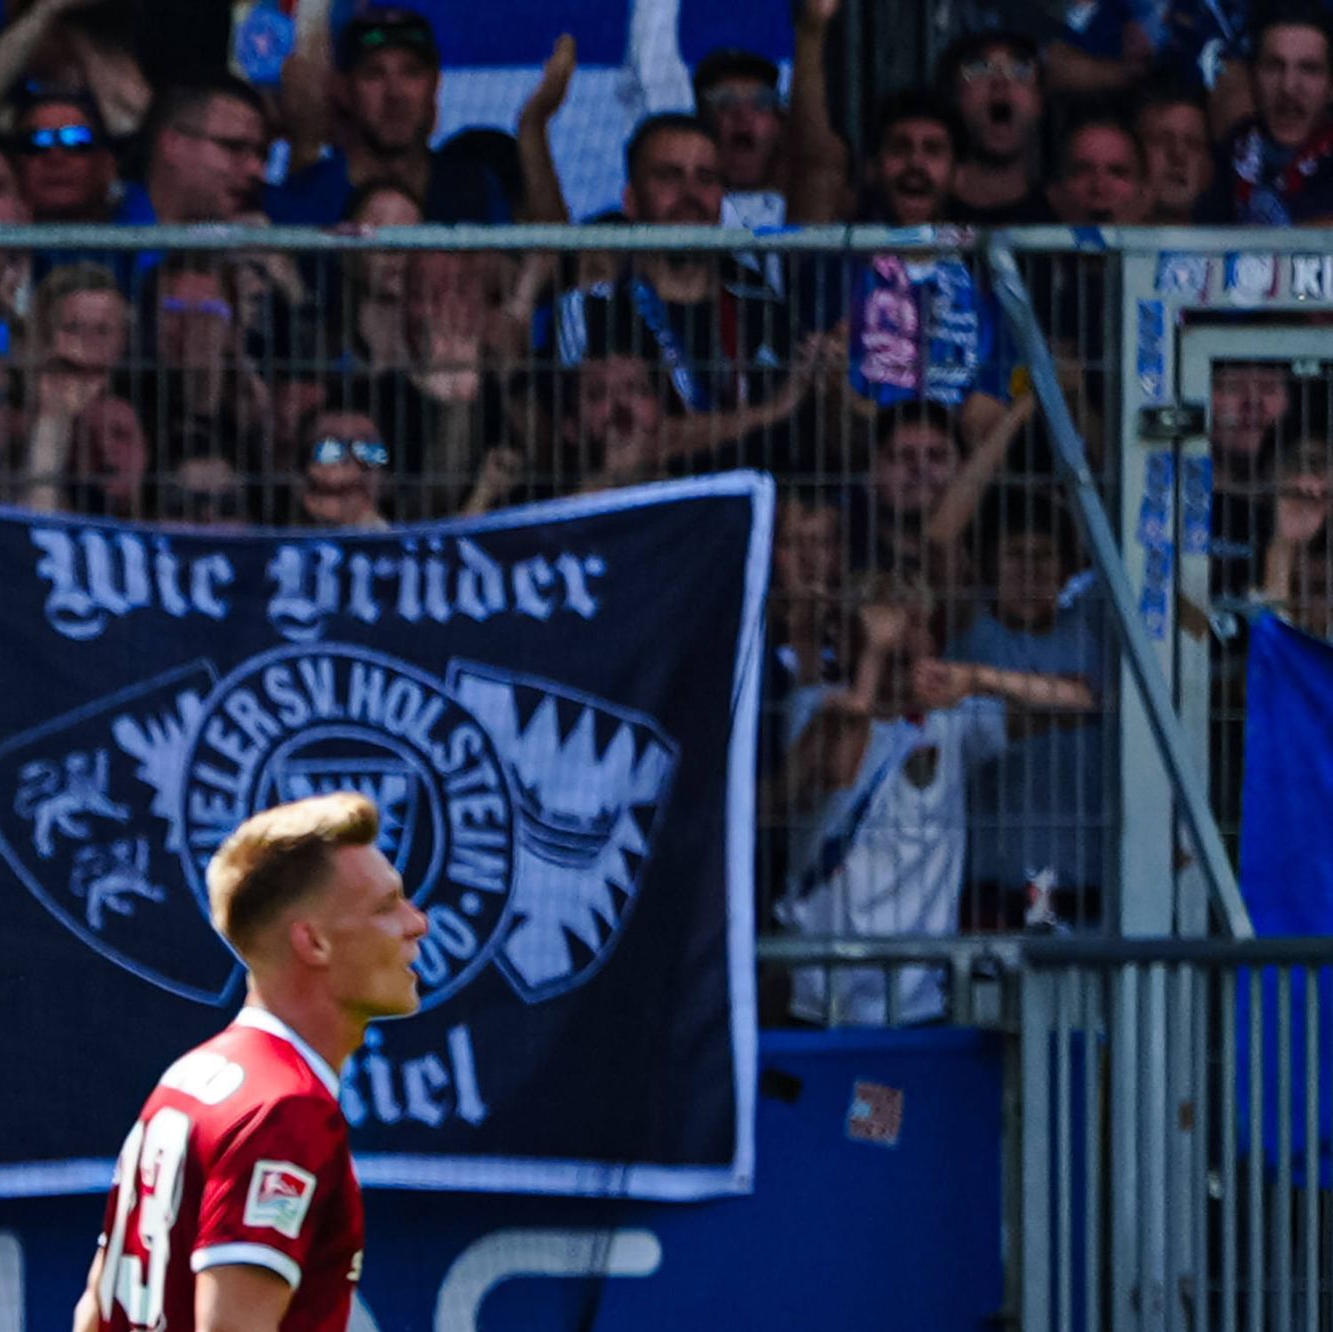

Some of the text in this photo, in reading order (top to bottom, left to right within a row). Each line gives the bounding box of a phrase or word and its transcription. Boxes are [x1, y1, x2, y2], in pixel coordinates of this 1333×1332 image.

[32, 526, 607, 642] Wie Brüder
[348, 660, 509, 893] HOLSTEIN
